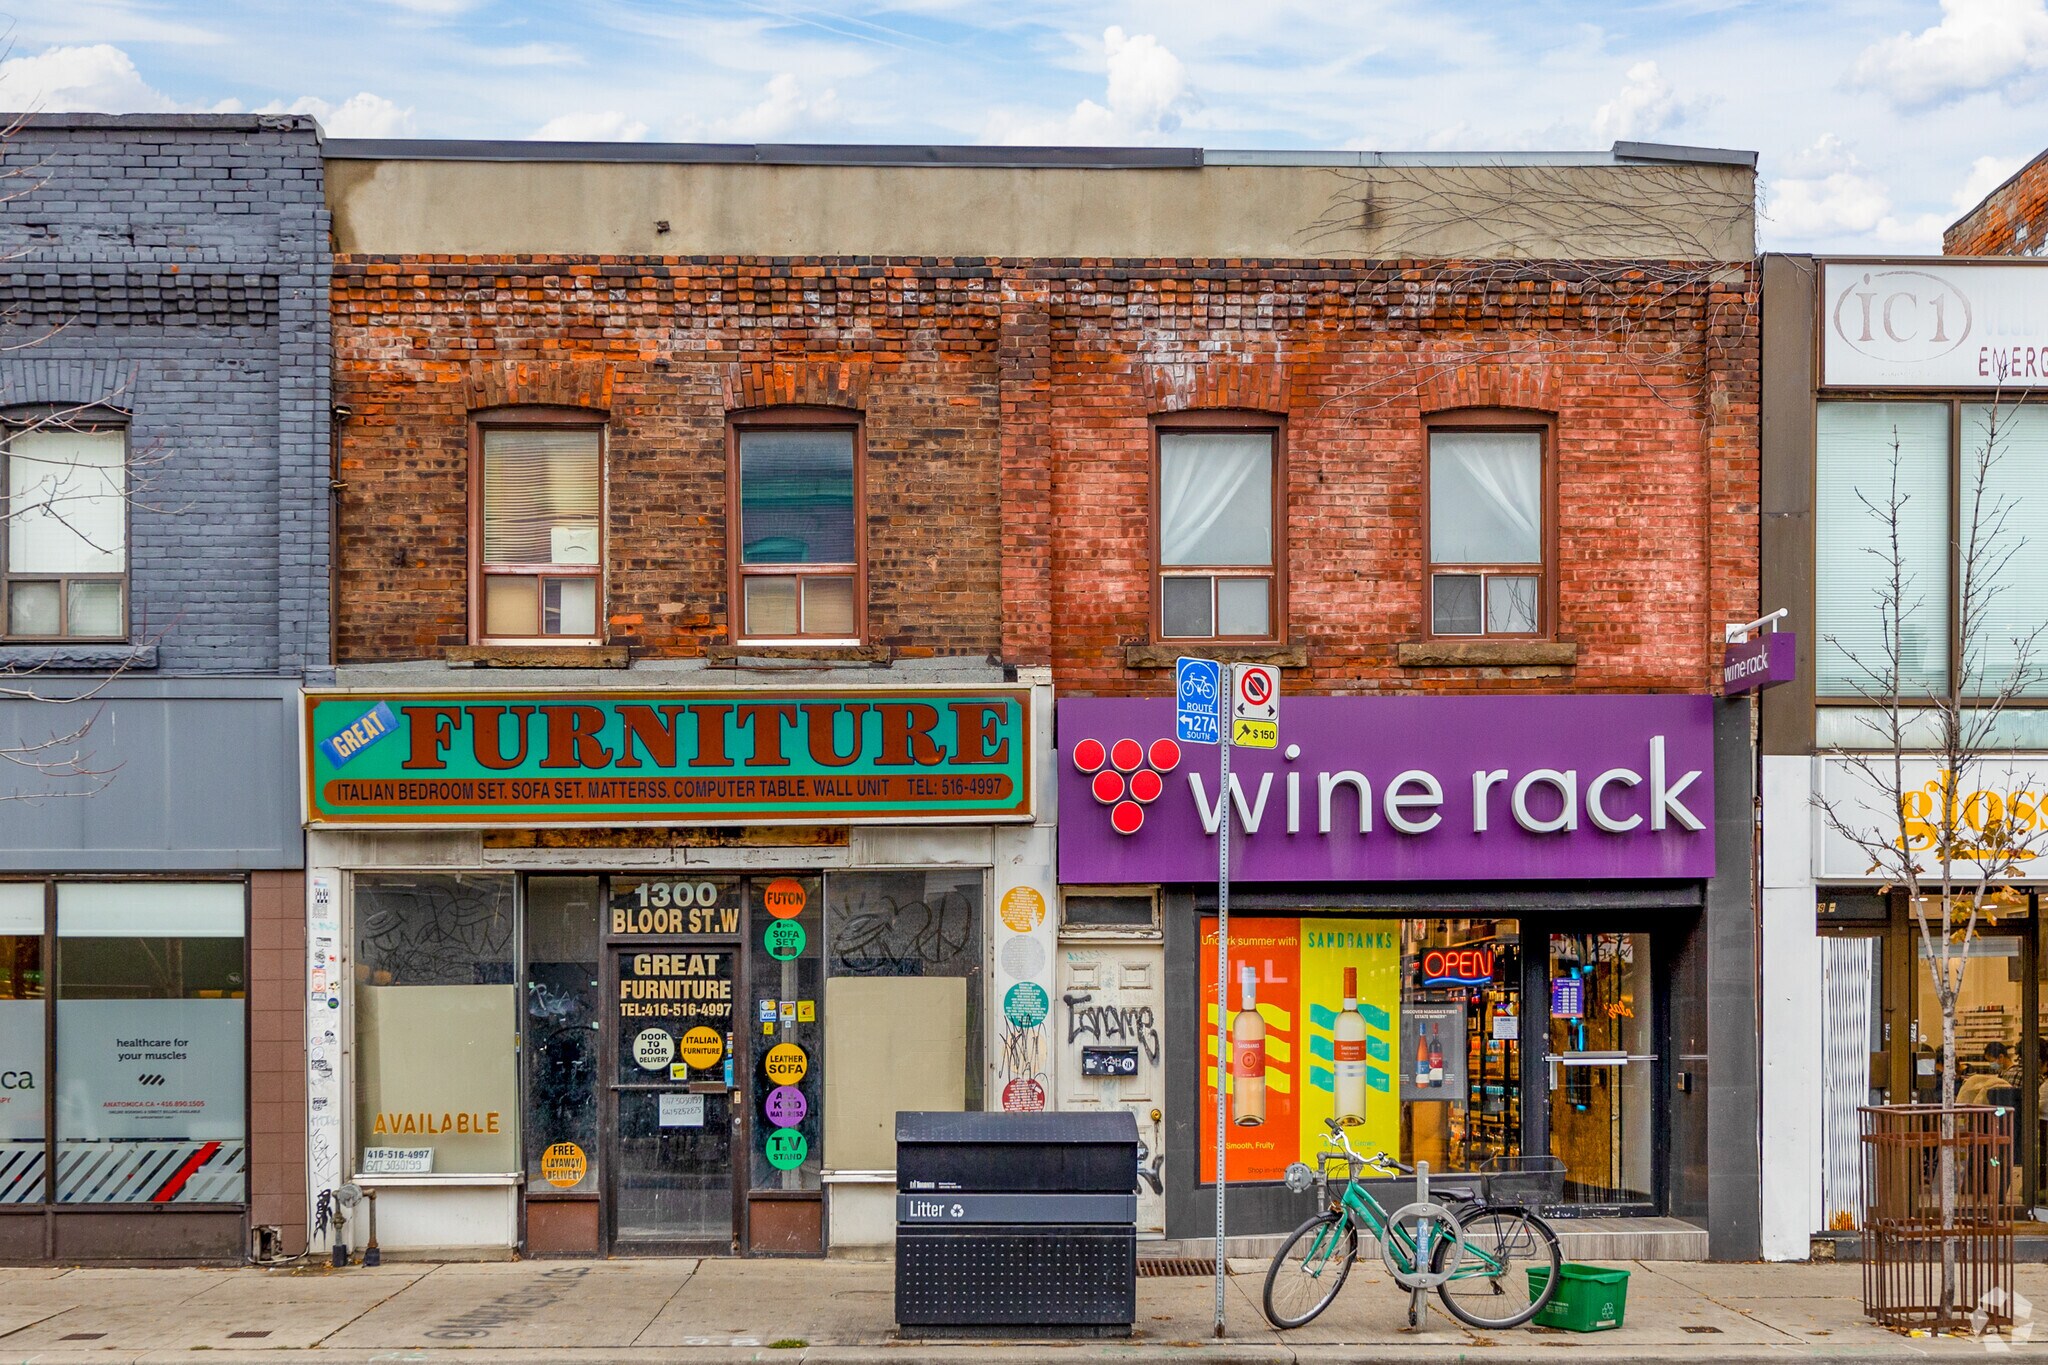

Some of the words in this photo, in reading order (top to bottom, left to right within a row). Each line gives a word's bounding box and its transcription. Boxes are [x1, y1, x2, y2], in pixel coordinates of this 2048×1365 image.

[1724, 658, 1746, 683] wine
[1747, 644, 1769, 675] rack
[1187, 702, 1213, 714] ROUTE
[1194, 716, 1218, 733] 27A
[332, 710, 387, 759] GREAT
[401, 702, 1009, 770] FURNITURE
[1187, 731, 1210, 741] SOUTH
[337, 783, 394, 801] ITALIAN
[400, 782, 473, 800] BEDROOM
[512, 781, 550, 800] SOFA
[673, 780, 755, 798] COMPUTER
[813, 779, 852, 797] WALL
[857, 779, 890, 797] UNIT
[908, 778, 938, 796] TEL:
[942, 777, 1001, 795] 516-4997
[1188, 744, 1444, 834] wine
[1473, 735, 1706, 833] rack
[1896, 769, 2048, 852] glos
[635, 882, 718, 907] 1300
[767, 892, 804, 905] FUTON
[612, 908, 683, 933] BLOOR
[773, 930, 799, 938] SOFA
[1308, 932, 1391, 948] SANDBANKS
[776, 938, 795, 946] SET
[1238, 937, 1275, 946] summer
[1278, 936, 1298, 945] with
[634, 954, 720, 976] GREAT
[1424, 951, 1493, 977] OPEN
[620, 980, 731, 999] FURNITURE
[620, 1003, 732, 1016] TEL:416-516-4997
[116, 1038, 171, 1047] healthcare
[174, 1038, 189, 1047] for
[641, 1033, 668, 1041] DOOR
[686, 1036, 718, 1044] ITALIAN
[118, 1052, 142, 1062] your
[145, 1051, 187, 1060] muscles
[770, 1055, 803, 1063] LEATHER
[769, 1064, 803, 1074] SOFA
[773, 1101, 801, 1109] KD
[373, 1111, 500, 1134] AVAILABLE
[553, 1145, 575, 1155] FREE
[771, 1136, 802, 1151] T.V
[1226, 1142, 1254, 1150] Smooth,
[367, 1150, 429, 1159] 416-516-4997
[547, 1170, 581, 1179] DELIVERY
[910, 1200, 945, 1217] Litter
